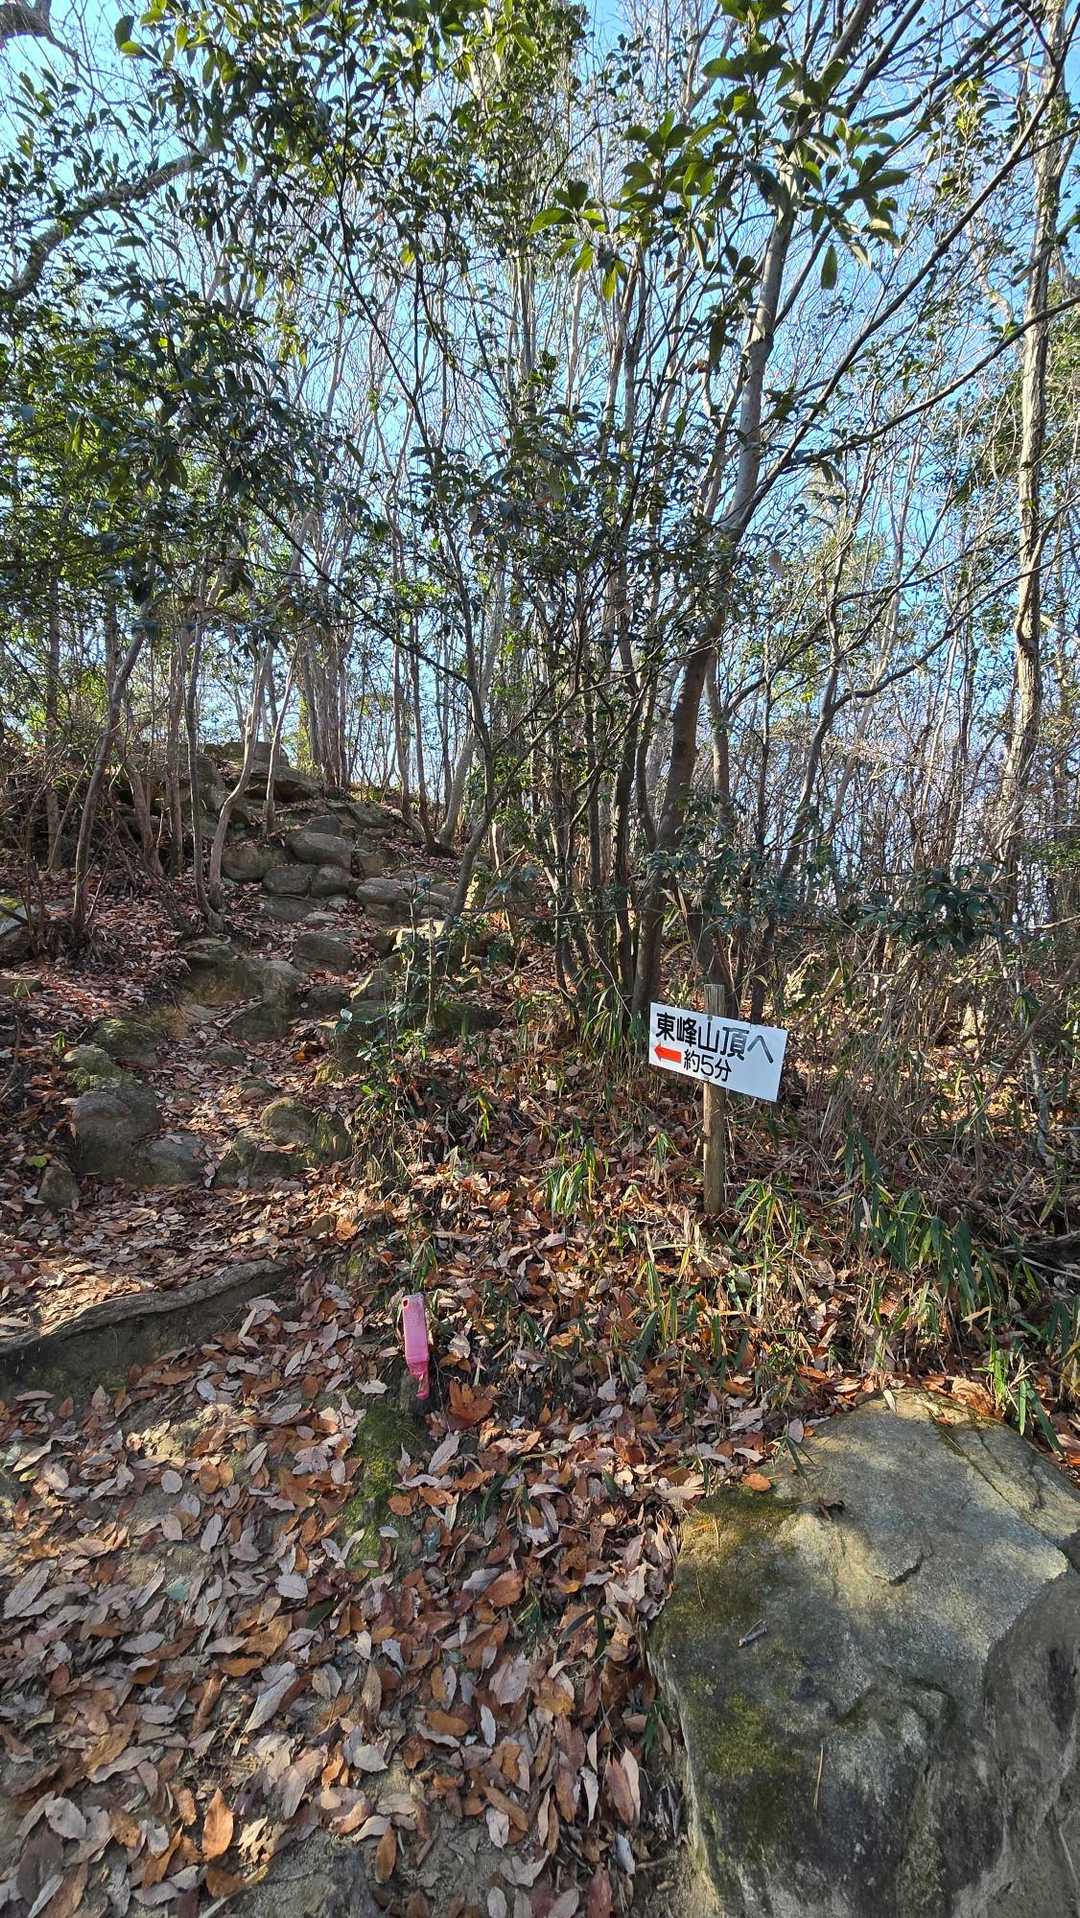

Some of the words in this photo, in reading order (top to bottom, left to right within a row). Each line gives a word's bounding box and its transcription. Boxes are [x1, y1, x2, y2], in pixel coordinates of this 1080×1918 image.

[656, 1012, 774, 1064] 東峰山頂へ
[684, 1048, 732, 1081] 約5分
